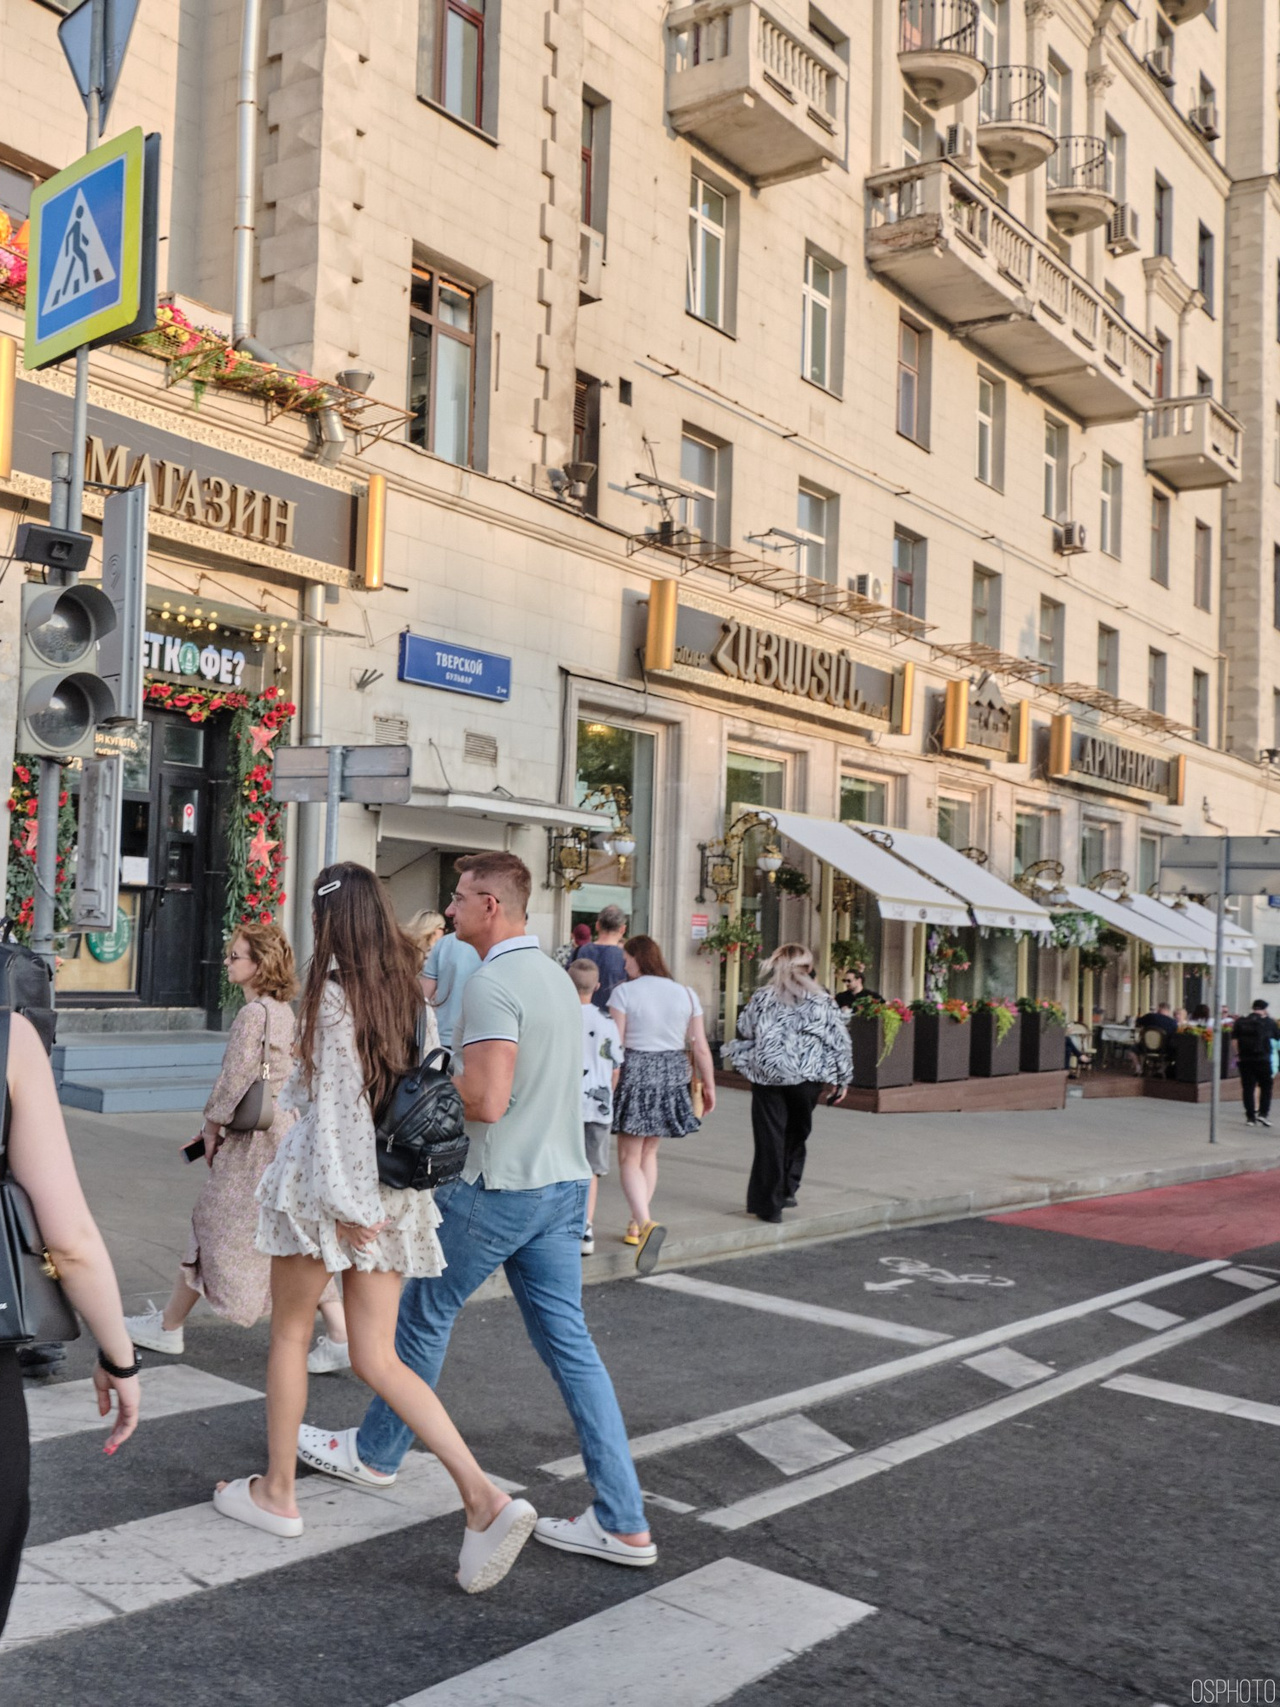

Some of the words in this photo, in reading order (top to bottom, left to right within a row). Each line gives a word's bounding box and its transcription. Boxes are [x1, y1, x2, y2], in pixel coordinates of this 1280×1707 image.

[86, 435, 298, 550] МАГАЗИН
[435, 651, 484, 676] ТВЕРСКОЙ
[445, 671, 473, 685] БУЛЬВАР
[1082, 736, 1158, 792] АРМЕНИЯ
[302, 1450, 338, 1472] crocs
